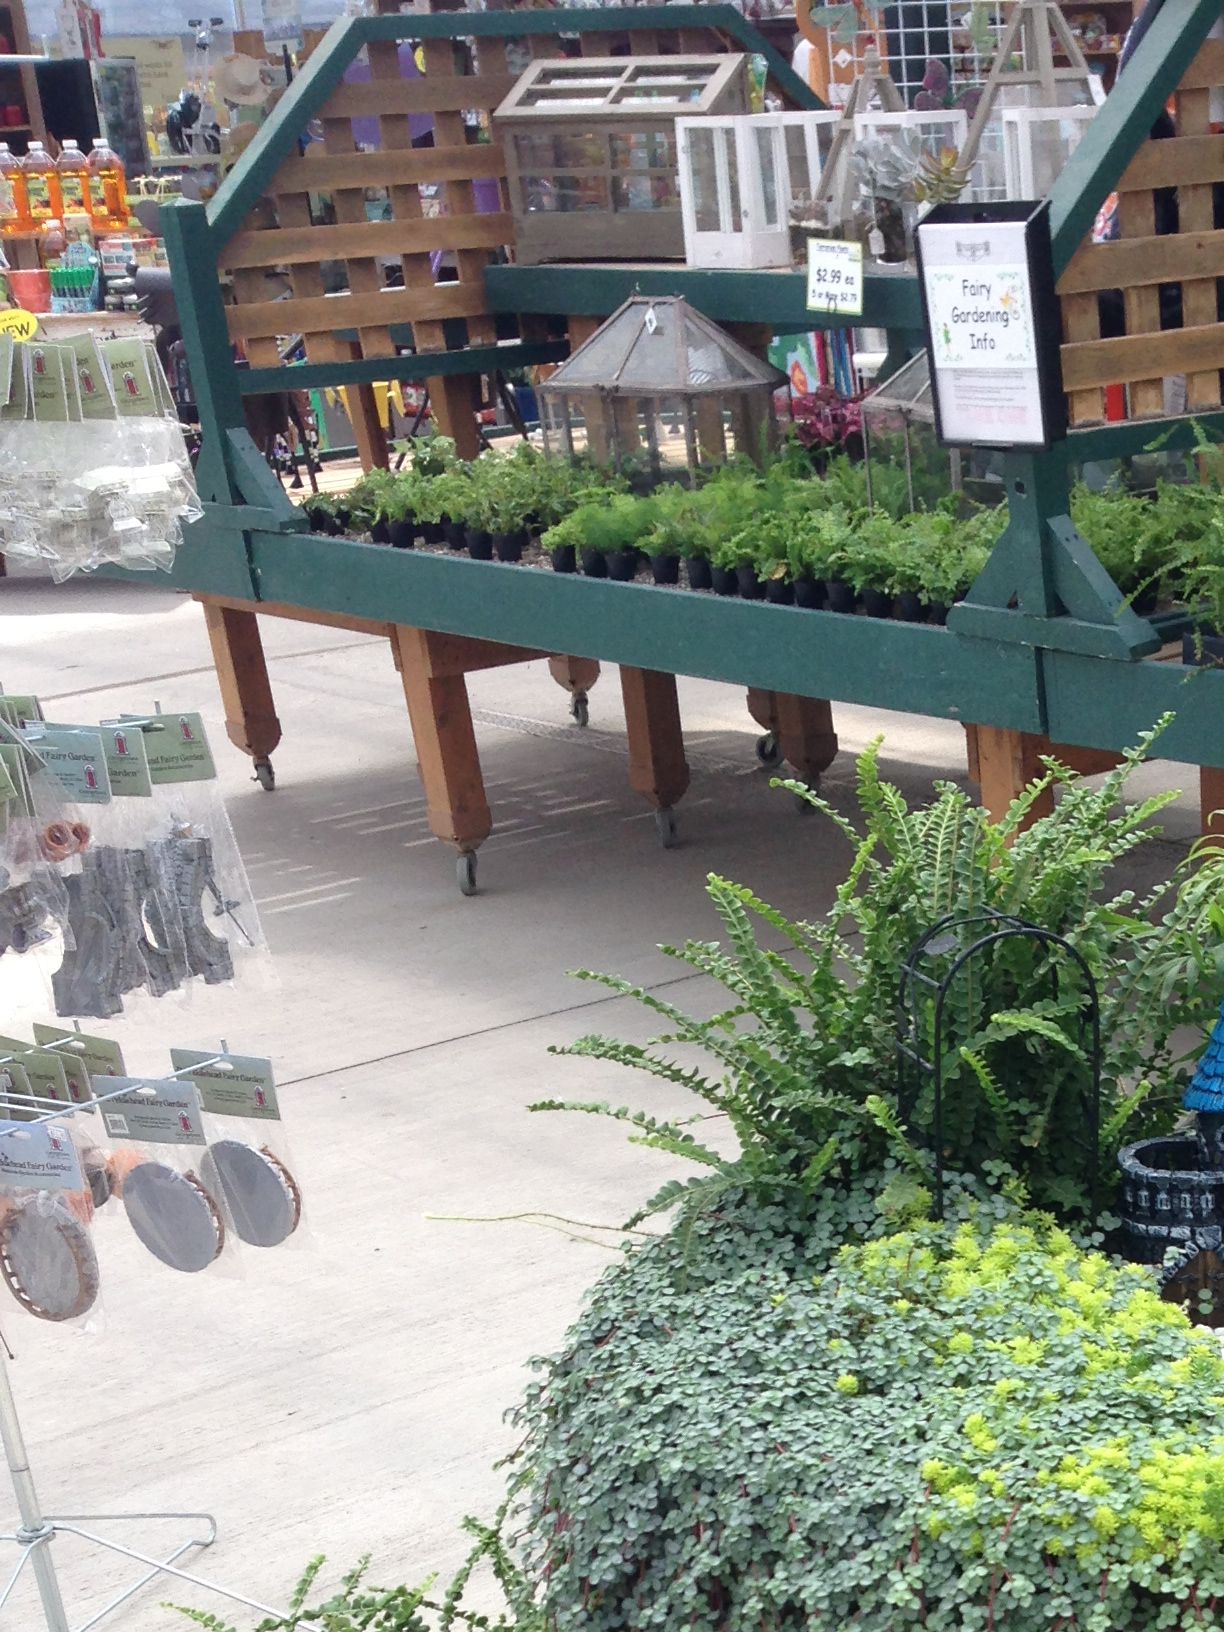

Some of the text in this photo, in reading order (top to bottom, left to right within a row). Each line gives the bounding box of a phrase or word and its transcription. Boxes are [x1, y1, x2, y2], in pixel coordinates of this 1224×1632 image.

[816, 267, 841, 284] $2.99
[962, 279, 992, 299] Fairy
[951, 307, 1009, 328] Gardening
[969, 332, 995, 350] Info
